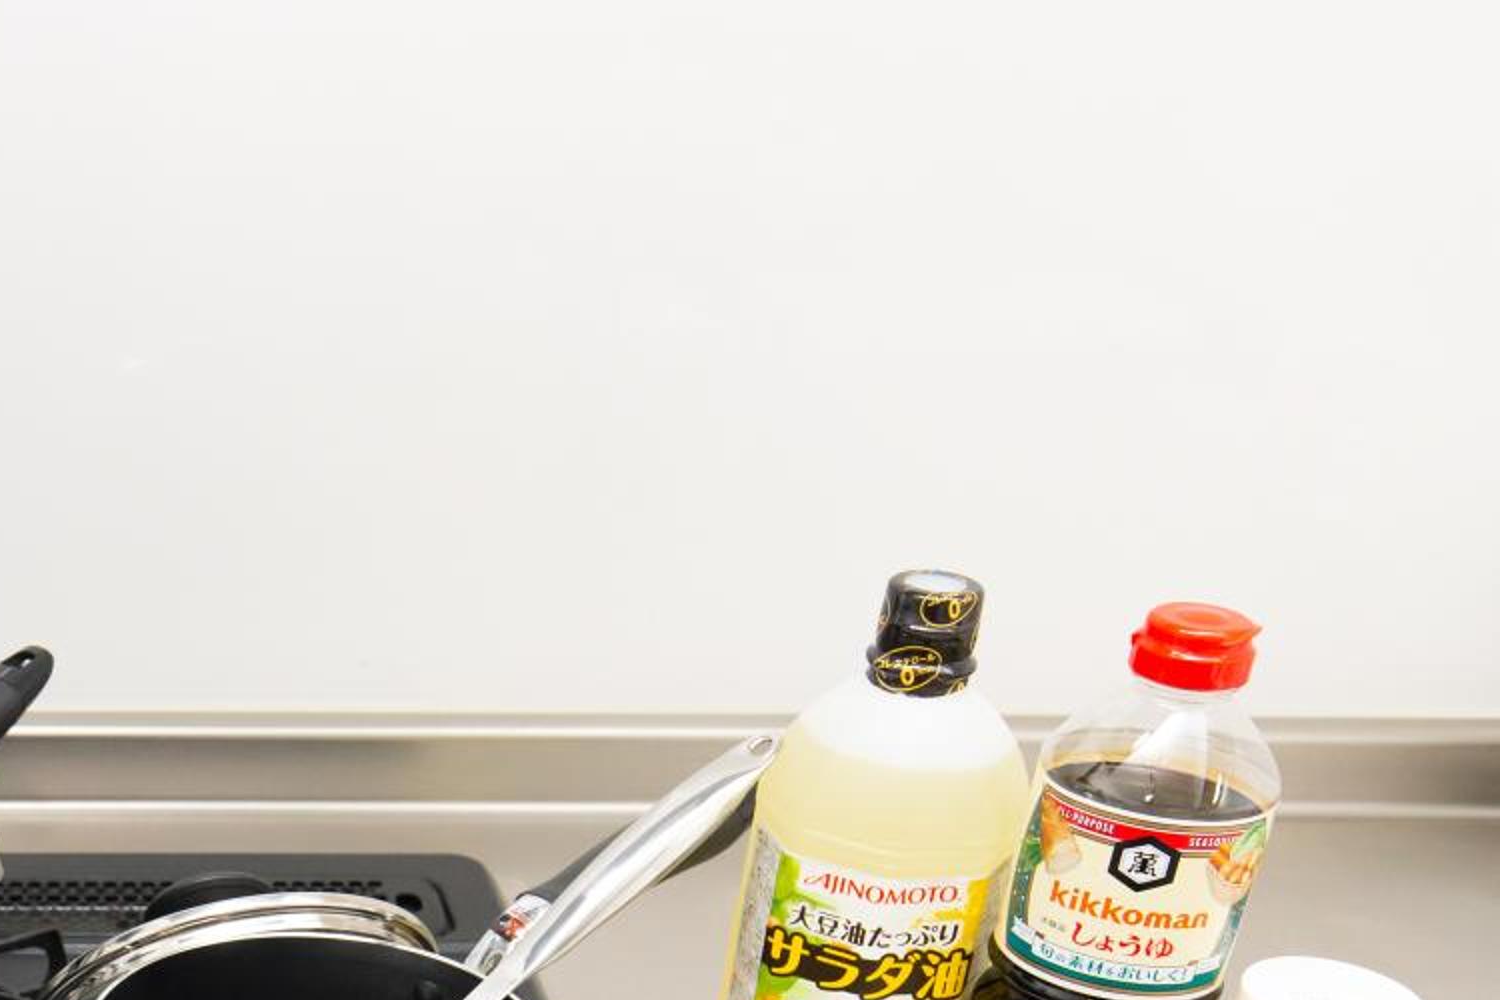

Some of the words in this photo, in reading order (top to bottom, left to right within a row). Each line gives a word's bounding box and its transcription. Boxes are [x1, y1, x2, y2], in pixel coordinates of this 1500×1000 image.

[803, 872, 959, 906] AJINOMOTO
[1049, 880, 1209, 930] kikkoman
[788, 904, 960, 949] 大豆油たっぷり
[1070, 921, 1175, 960] しょうゆ
